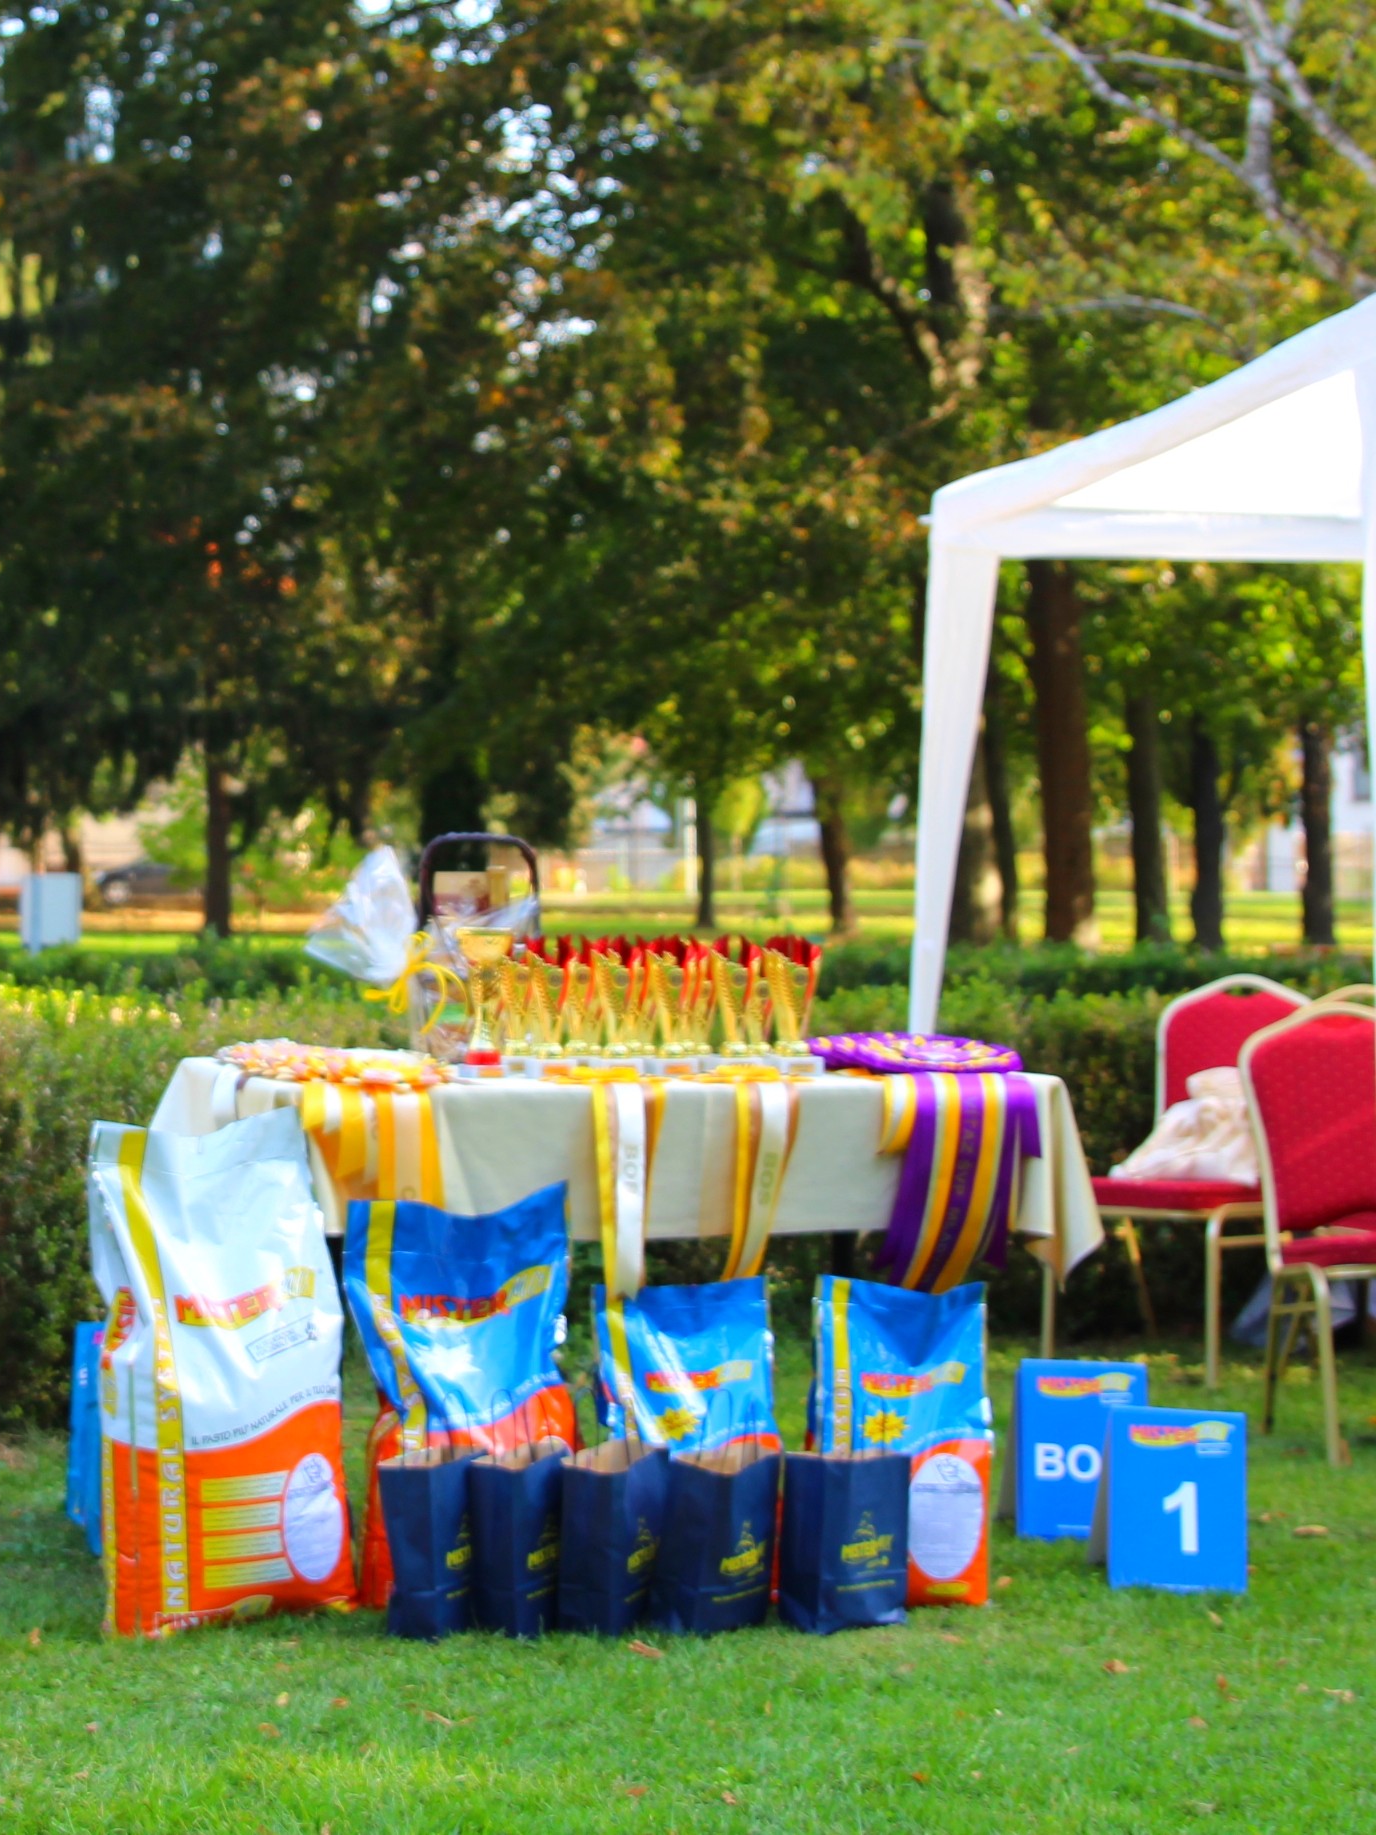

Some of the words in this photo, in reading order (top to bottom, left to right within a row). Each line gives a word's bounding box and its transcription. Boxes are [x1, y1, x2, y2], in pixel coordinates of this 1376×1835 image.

[400, 1290, 511, 1320] MISTER
[202, 1430, 231, 1444] PASTO
[250, 1402, 288, 1430] NATURALE
[290, 1391, 304, 1405] PER
[1034, 1442, 1102, 1481] BO
[161, 1441, 184, 1608] NATURAL
[1162, 1481, 1199, 1555] 1
